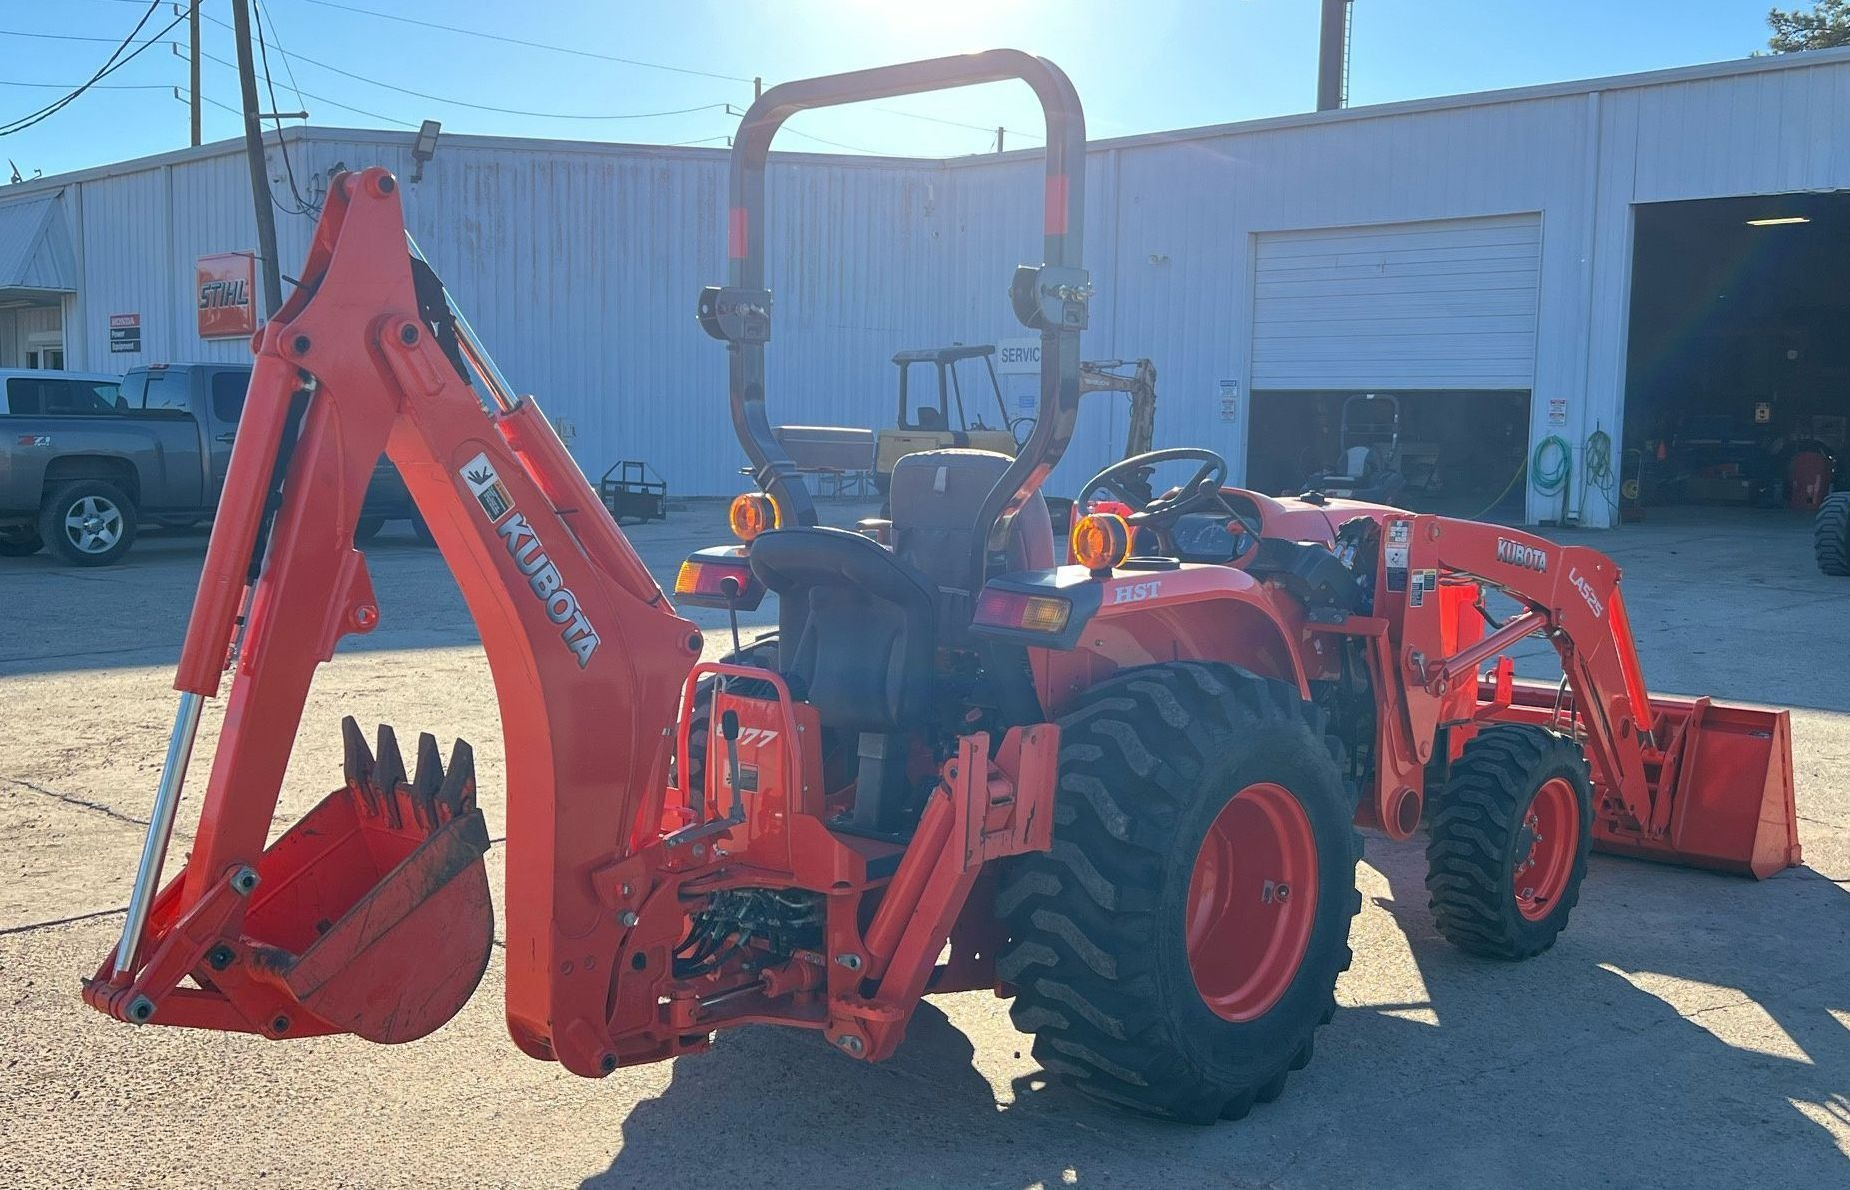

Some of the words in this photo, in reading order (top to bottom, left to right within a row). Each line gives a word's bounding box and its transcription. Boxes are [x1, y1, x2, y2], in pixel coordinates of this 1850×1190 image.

[200, 279, 249, 310] STIHL
[1001, 347, 1041, 363] SERVIC
[1497, 537, 1548, 573] KUBOTA
[497, 513, 601, 670] KUBOTA
[1113, 581, 1161, 604] HST
[1568, 566, 1603, 618] LA525
